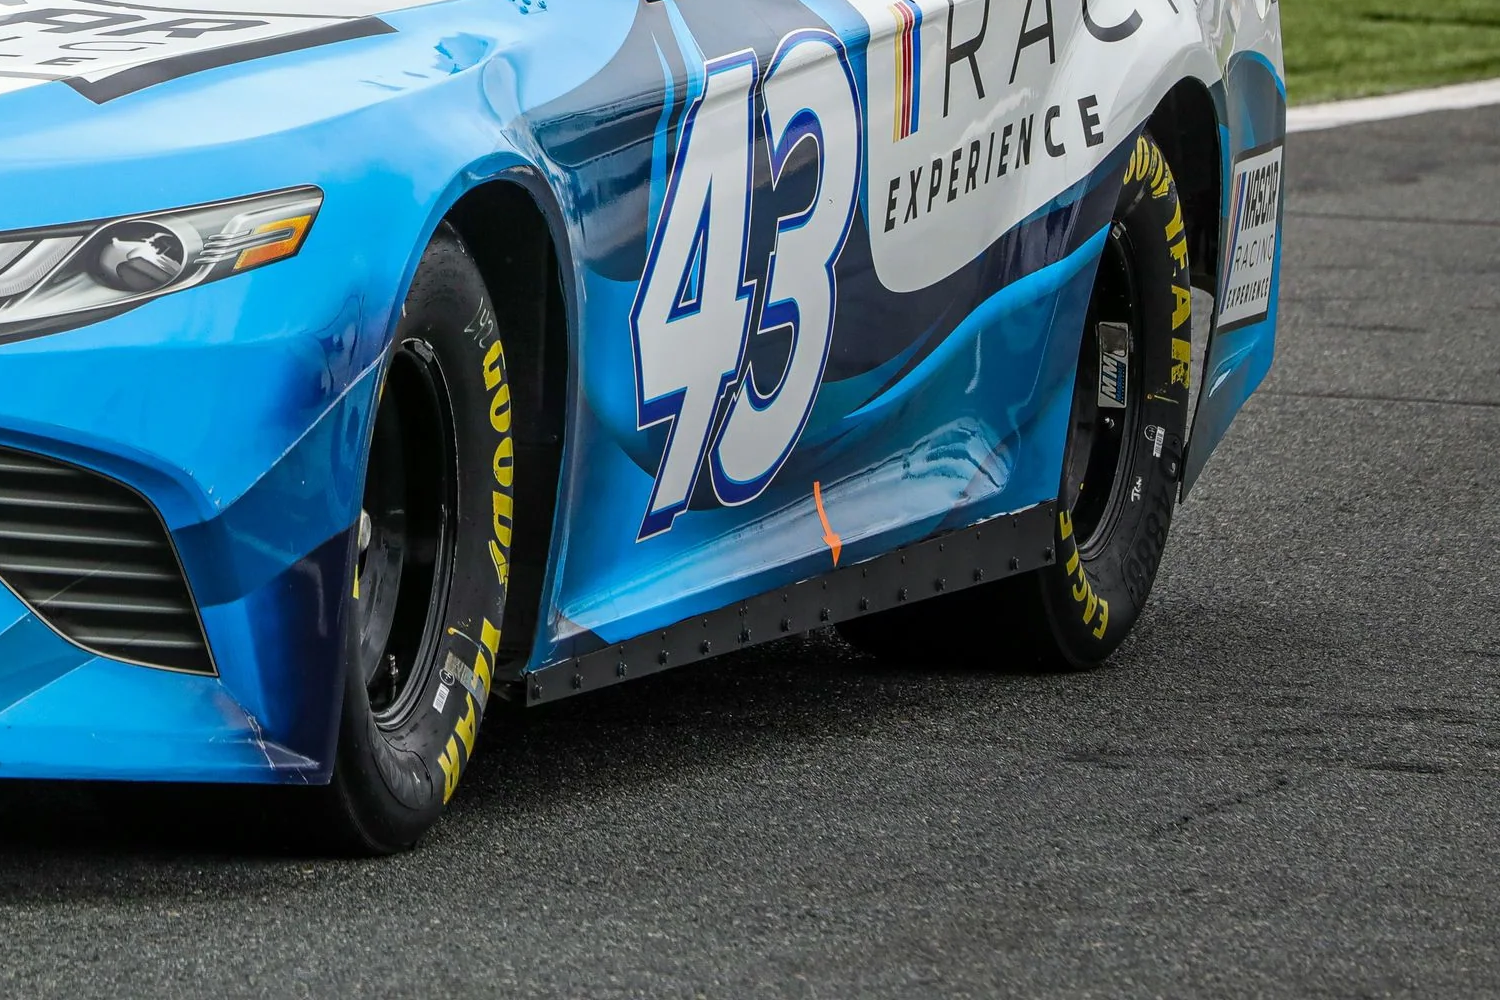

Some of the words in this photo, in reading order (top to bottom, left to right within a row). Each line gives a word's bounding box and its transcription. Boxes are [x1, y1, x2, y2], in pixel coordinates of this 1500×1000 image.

[884, 93, 1105, 233] EXPERIENCE
[1241, 160, 1279, 232] NASCAR
[628, 28, 863, 543] 43
[1233, 234, 1274, 273] RACING
[1226, 277, 1269, 310] EXPERIENCE
